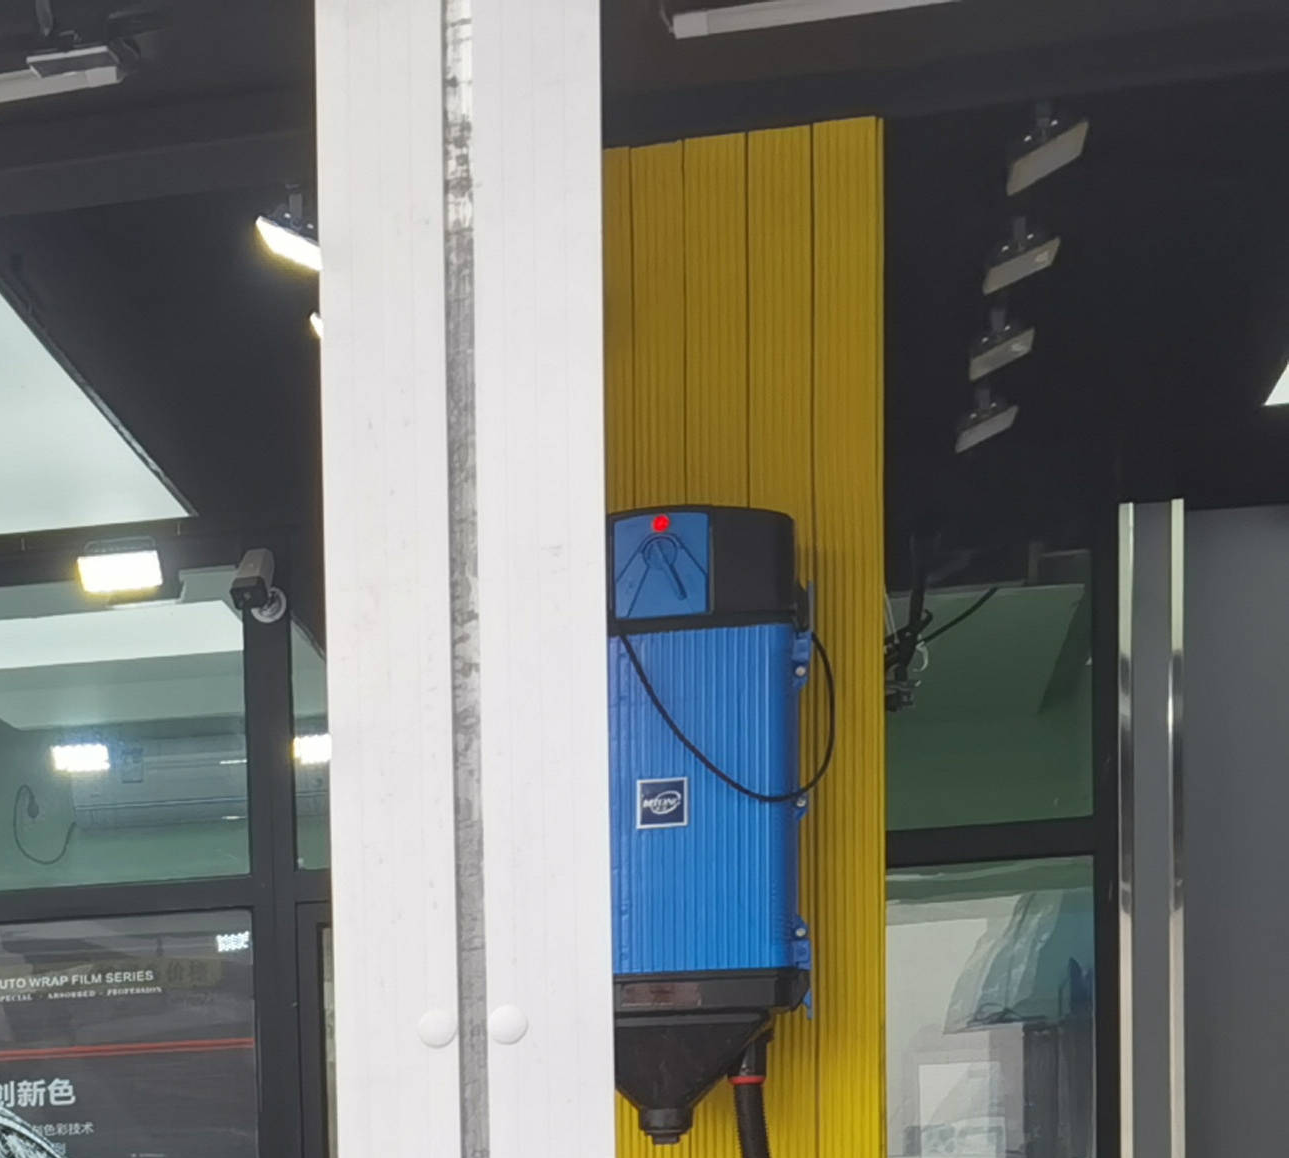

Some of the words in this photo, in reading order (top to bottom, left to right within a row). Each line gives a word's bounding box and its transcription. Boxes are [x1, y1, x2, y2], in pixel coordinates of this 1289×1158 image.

[29, 975, 69, 988] WRAP
[71, 973, 102, 985] FILM
[105, 970, 154, 983] SERIES
